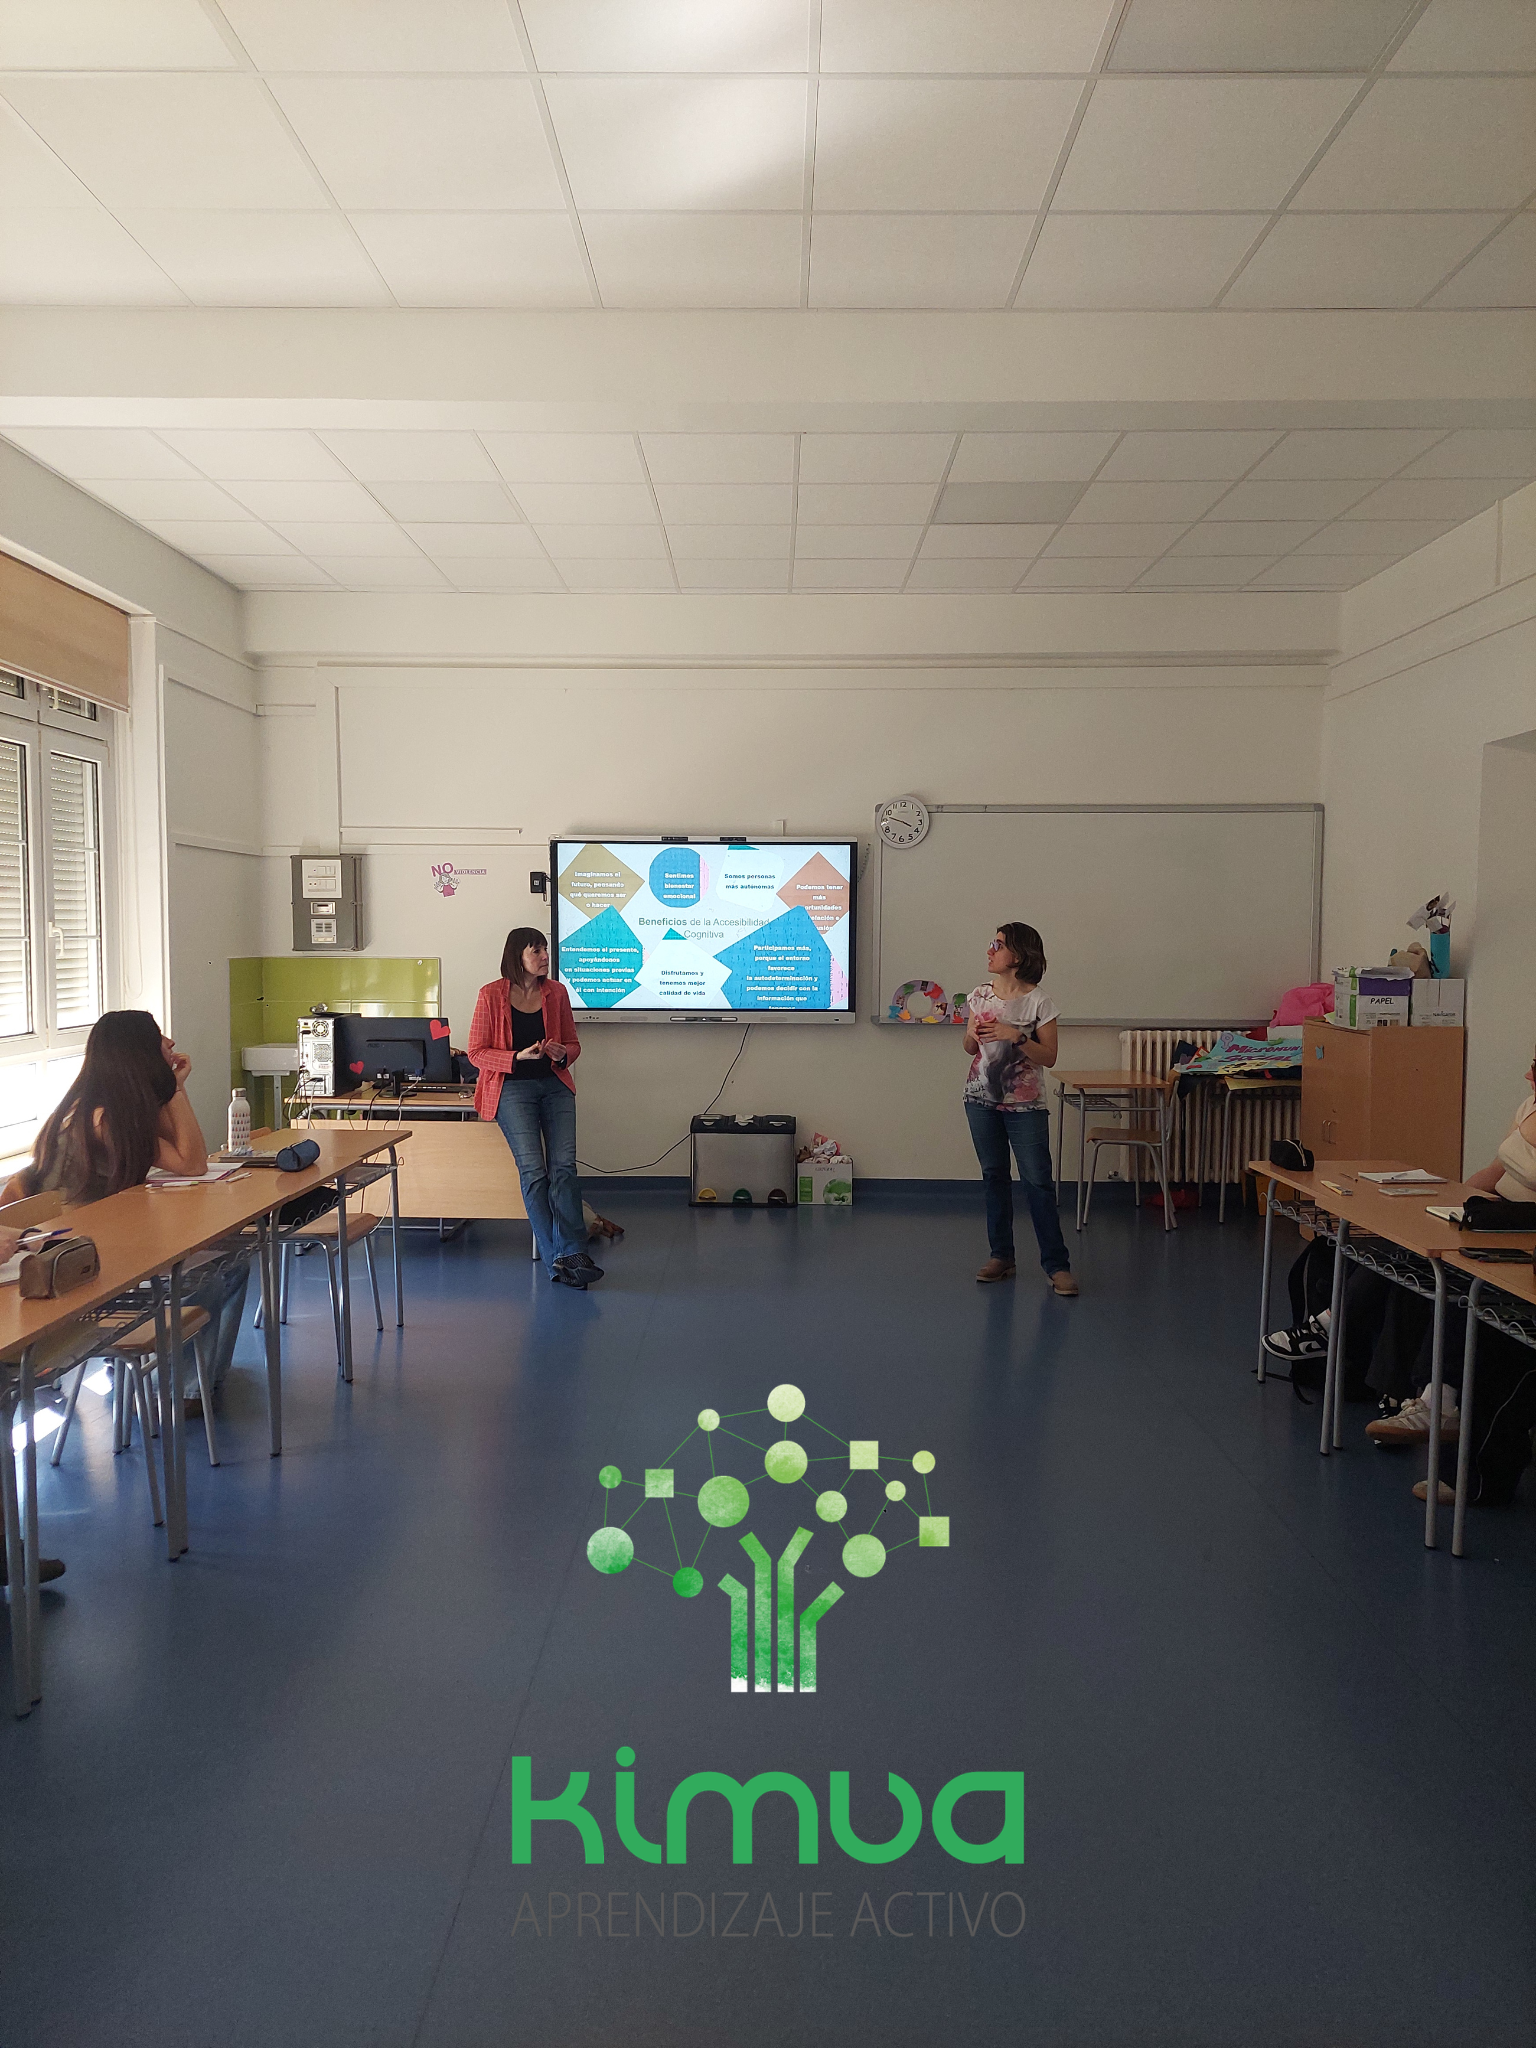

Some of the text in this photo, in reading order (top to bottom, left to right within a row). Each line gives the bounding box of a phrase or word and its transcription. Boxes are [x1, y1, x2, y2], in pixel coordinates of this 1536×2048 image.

[431, 862, 453, 877] NO
[639, 918, 769, 927] Beneficios de la Accesibilidad
[684, 930, 724, 939] Cognitiva
